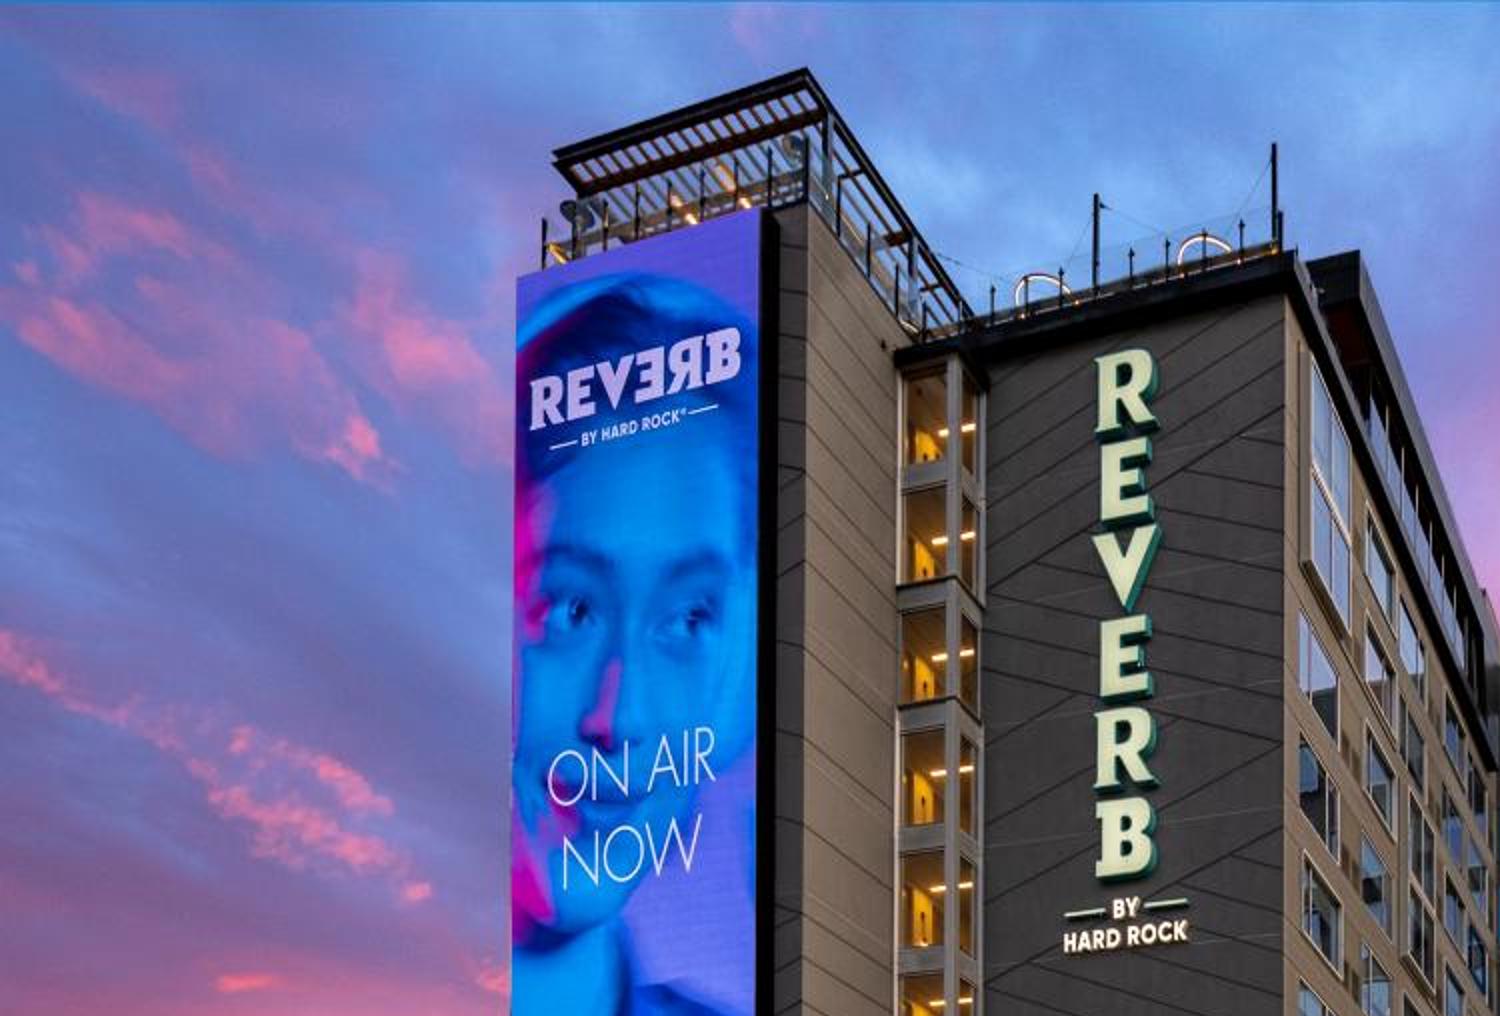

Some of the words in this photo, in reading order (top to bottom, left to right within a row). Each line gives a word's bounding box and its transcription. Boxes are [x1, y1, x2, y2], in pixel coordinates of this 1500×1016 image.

[530, 327, 741, 431] REVERB
[581, 429, 597, 446] BY
[601, 420, 637, 441] HARD
[1091, 349, 1159, 881] REVERB
[548, 739, 629, 807] ON
[647, 726, 717, 793] AIR
[562, 812, 702, 892] NOW
[1063, 928, 1121, 954] HARD
[1127, 919, 1188, 945] ROCK
[1113, 897, 1139, 920] BY
